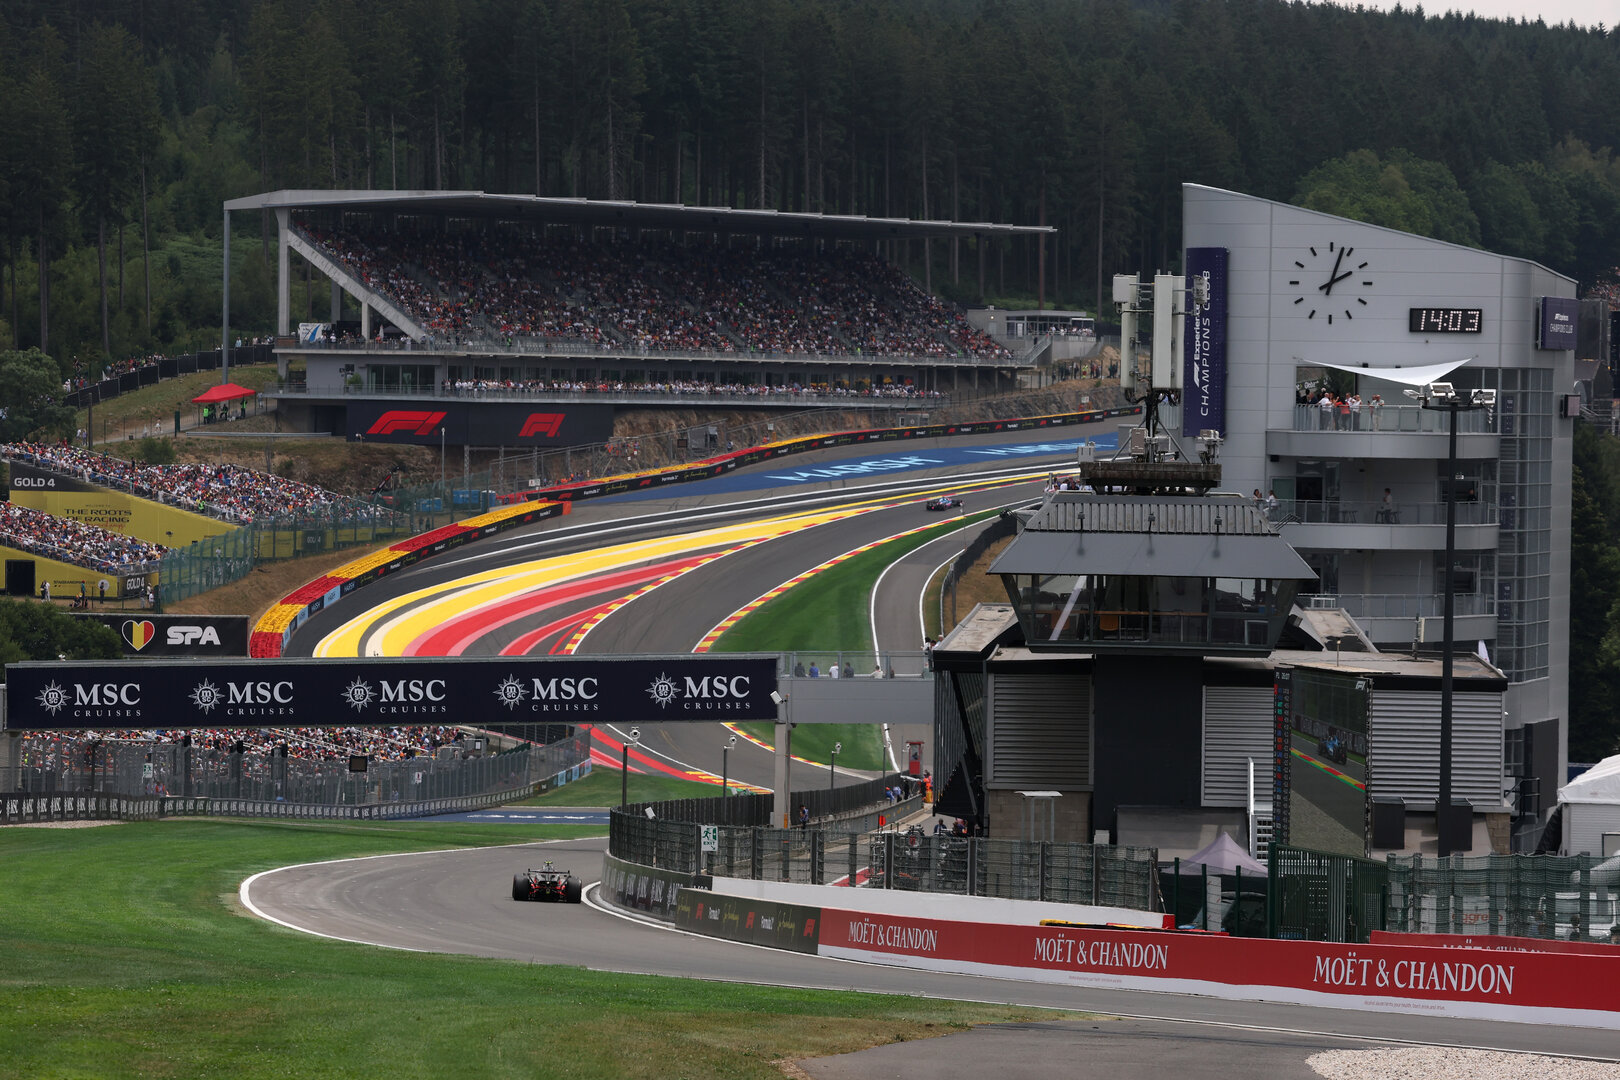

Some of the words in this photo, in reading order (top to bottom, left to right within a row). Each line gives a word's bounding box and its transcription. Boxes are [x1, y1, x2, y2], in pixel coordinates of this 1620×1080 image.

[1420, 310, 1480, 331] 14:03
[1200, 317, 1210, 416] CHAMPIONS
[366, 410, 448, 436] F1
[518, 413, 566, 437] F1
[14, 477, 45, 487] GOLD
[47, 478, 56, 487] 4
[126, 577, 140, 591] GOLD
[140, 576, 145, 589] 4
[166, 625, 221, 646] SPA
[74, 683, 141, 706] MSC
[226, 681, 294, 704] MSC
[379, 679, 446, 702] MSC
[531, 677, 598, 700] MSC
[683, 675, 750, 698] MSC
[74, 709, 141, 717] CRUISES
[227, 707, 294, 715] CRUISES
[379, 705, 446, 714] CRUISES
[531, 703, 599, 711] CRUISES
[683, 702, 751, 710] CRUISES
[848, 918, 877, 943] MOËT
[877, 924, 885, 946] &
[886, 925, 938, 951] CHANDON
[1034, 933, 1076, 962] MOËT
[1077, 939, 1088, 964] &
[1089, 940, 1169, 970] CHANDON
[1313, 951, 1373, 987] MOËT
[1375, 958, 1390, 988] &
[1393, 958, 1515, 996] CHANDON
